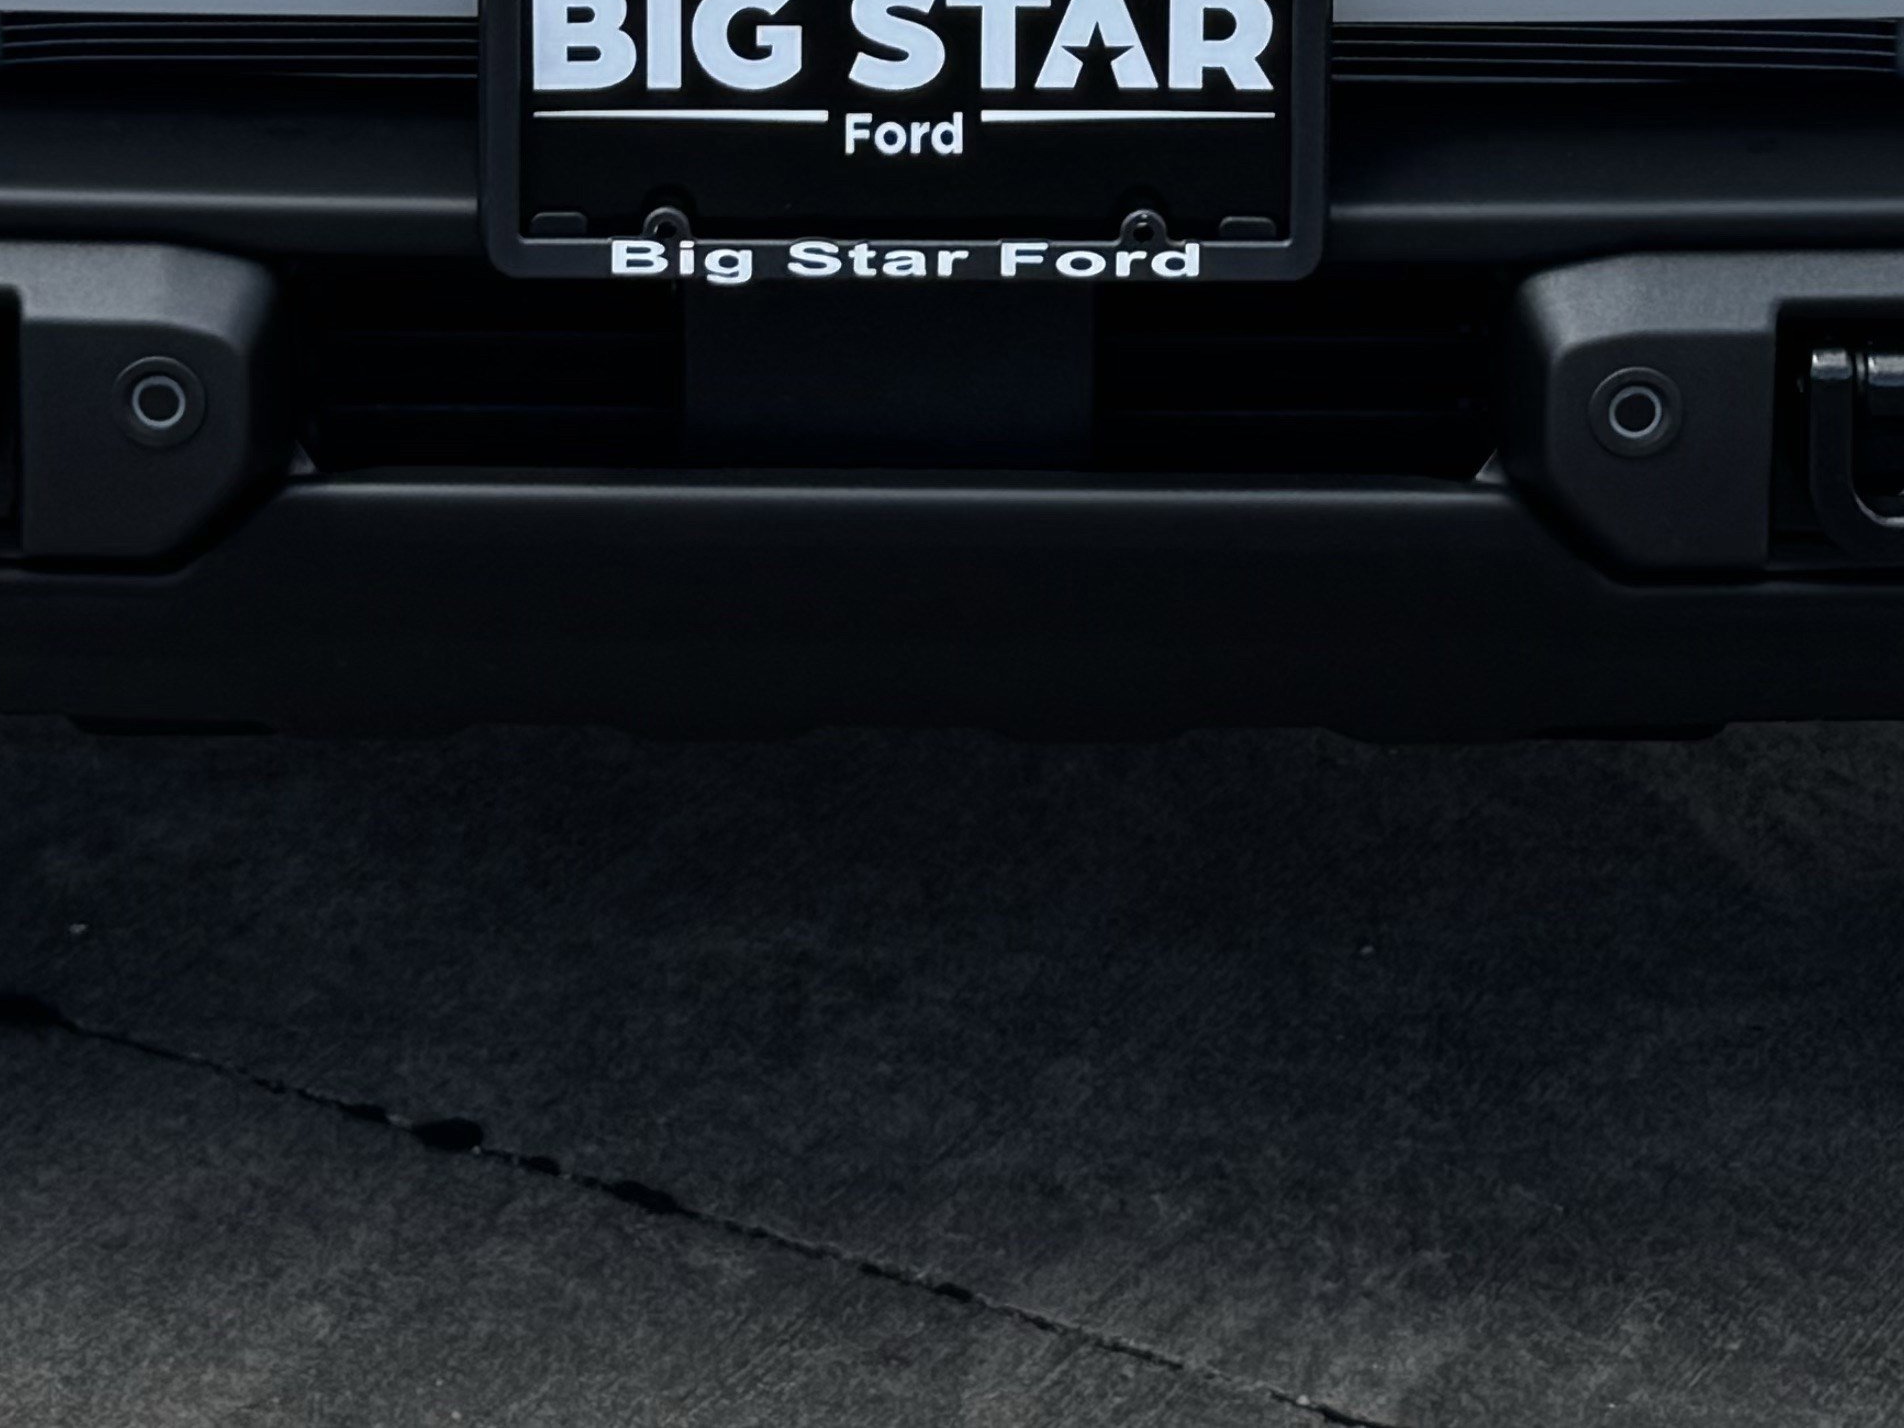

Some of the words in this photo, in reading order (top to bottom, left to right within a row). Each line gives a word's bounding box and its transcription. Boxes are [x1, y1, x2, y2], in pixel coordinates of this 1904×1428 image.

[844, 111, 964, 156] Ford
[610, 239, 754, 285] Big
[786, 240, 969, 278] Star
[1000, 241, 1201, 278] Ford
